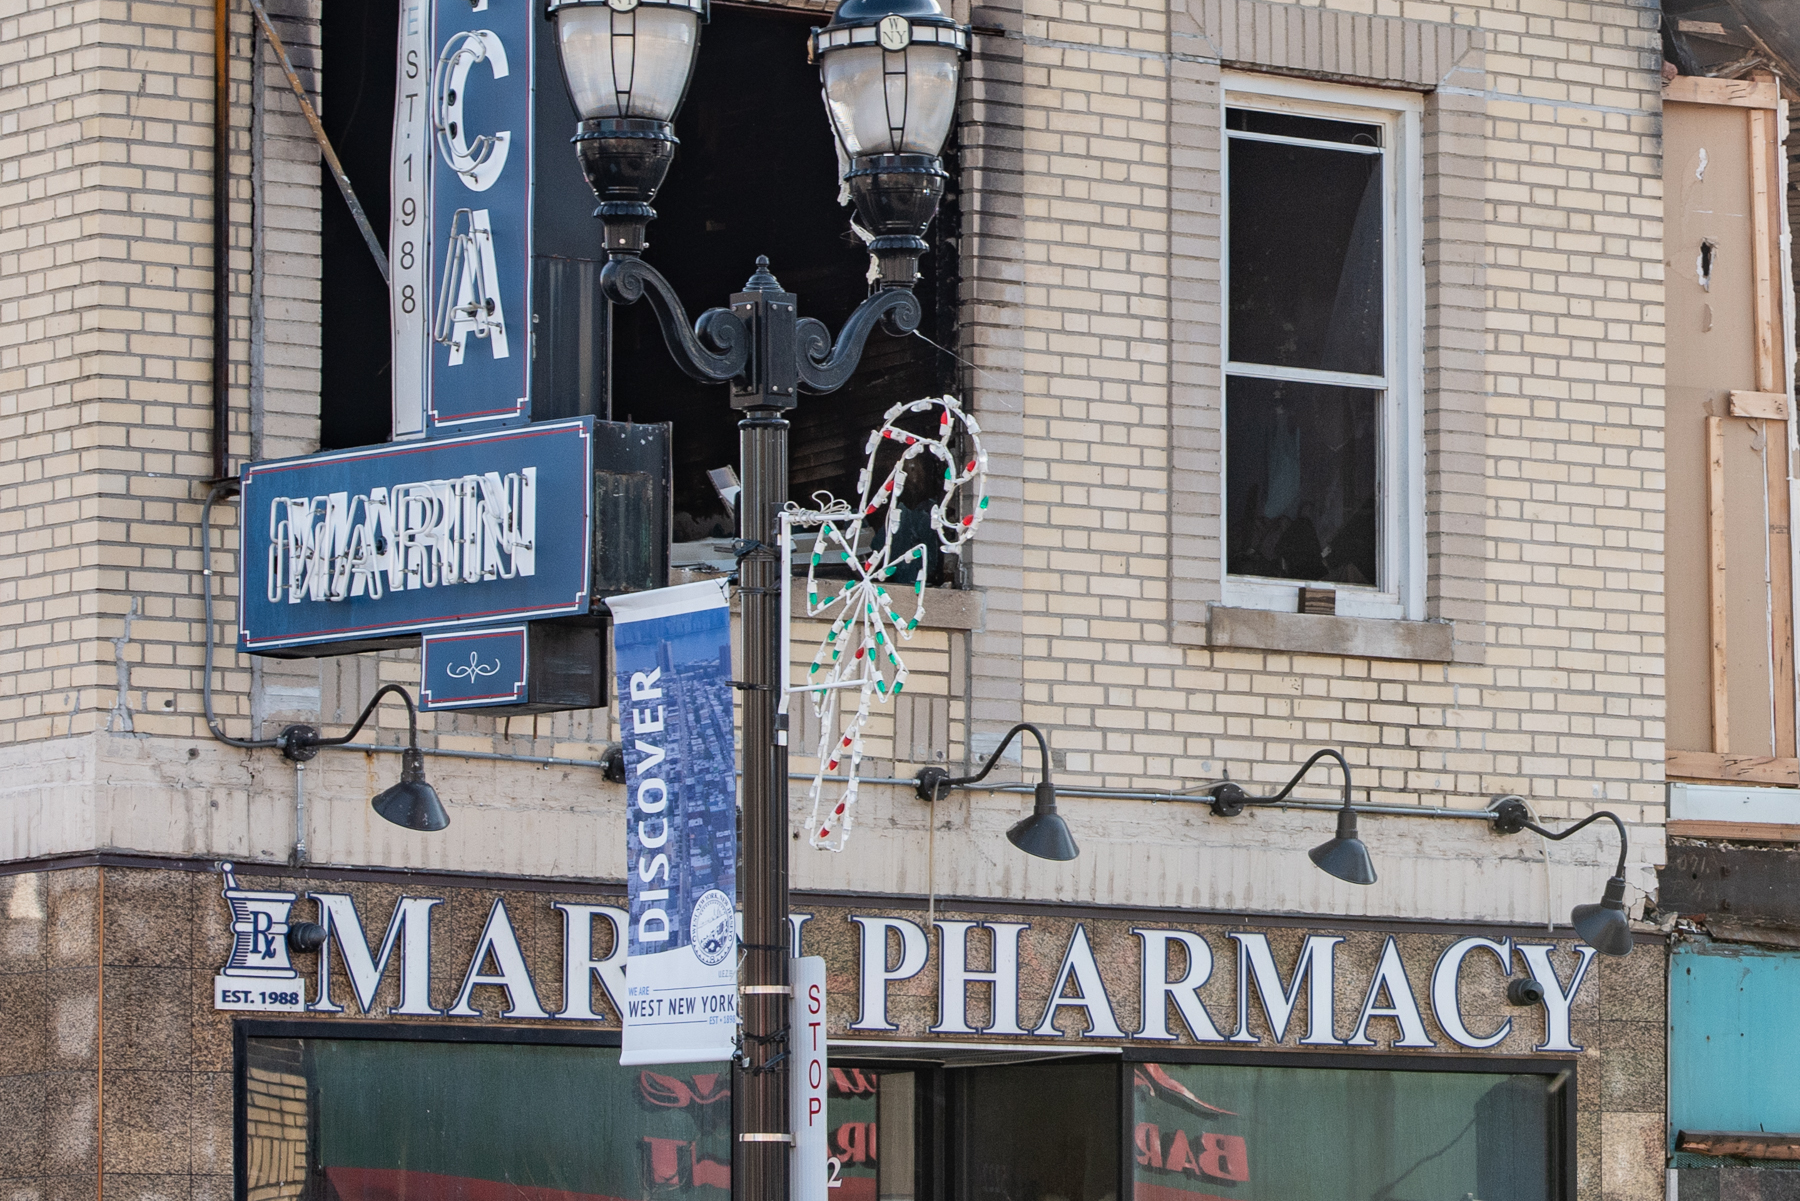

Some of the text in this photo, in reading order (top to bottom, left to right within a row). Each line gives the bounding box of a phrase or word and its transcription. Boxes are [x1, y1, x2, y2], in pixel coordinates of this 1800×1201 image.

[267, 466, 537, 604] MARIN
[630, 666, 670, 943] DISCOVER
[222, 989, 299, 1006] EST. 1988
[628, 986, 650, 997] WE ARE
[628, 994, 735, 1018] WEST NEW YORK
[847, 911, 1599, 1053] PHARMACY
[808, 984, 822, 1127] STOP
